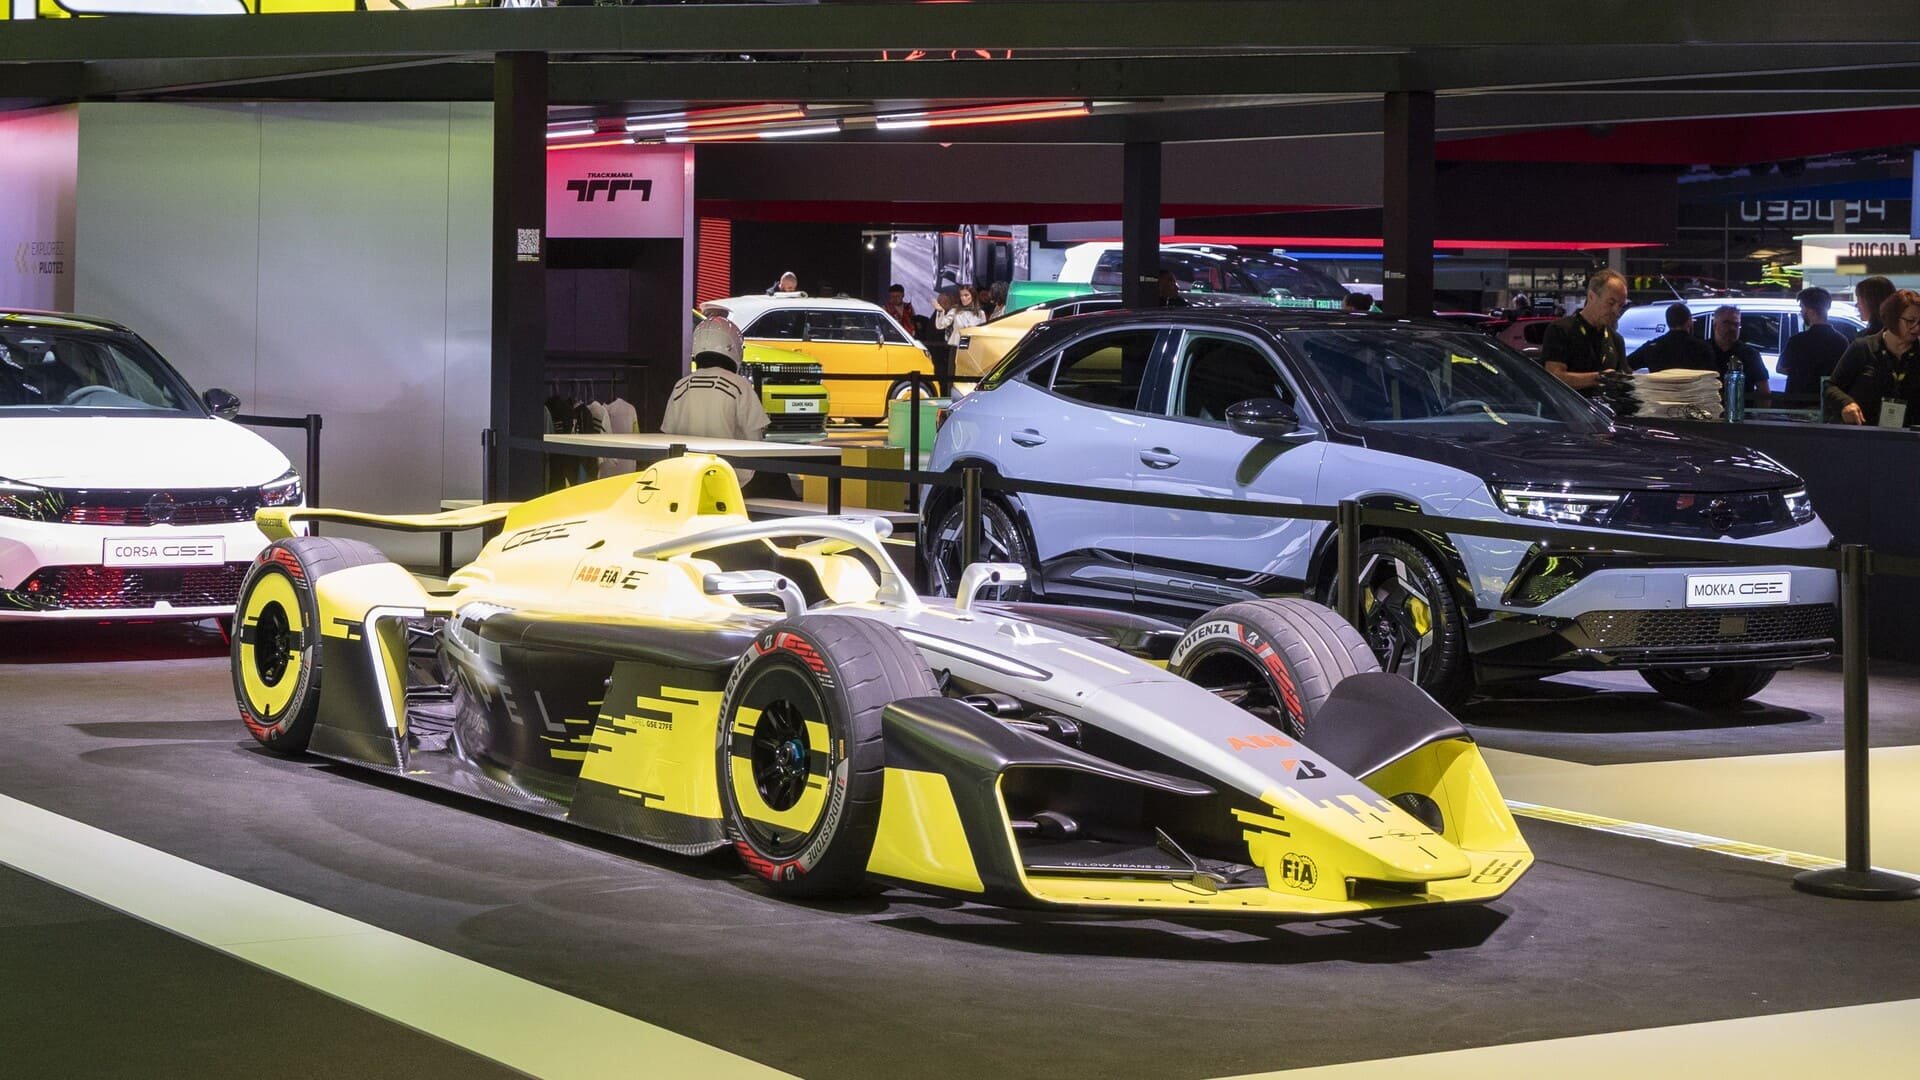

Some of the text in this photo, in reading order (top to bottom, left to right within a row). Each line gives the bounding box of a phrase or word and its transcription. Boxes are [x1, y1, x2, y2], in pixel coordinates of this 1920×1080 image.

[39, 261, 64, 274] PILOTEZ
[115, 545, 214, 558] CORSA GSE
[576, 566, 600, 583] ABB
[1694, 582, 1783, 596] MOKKA GSE
[1178, 624, 1230, 657] POTENZA
[717, 653, 751, 734] POTENZA
[807, 775, 847, 865] BRIDGESTONE
